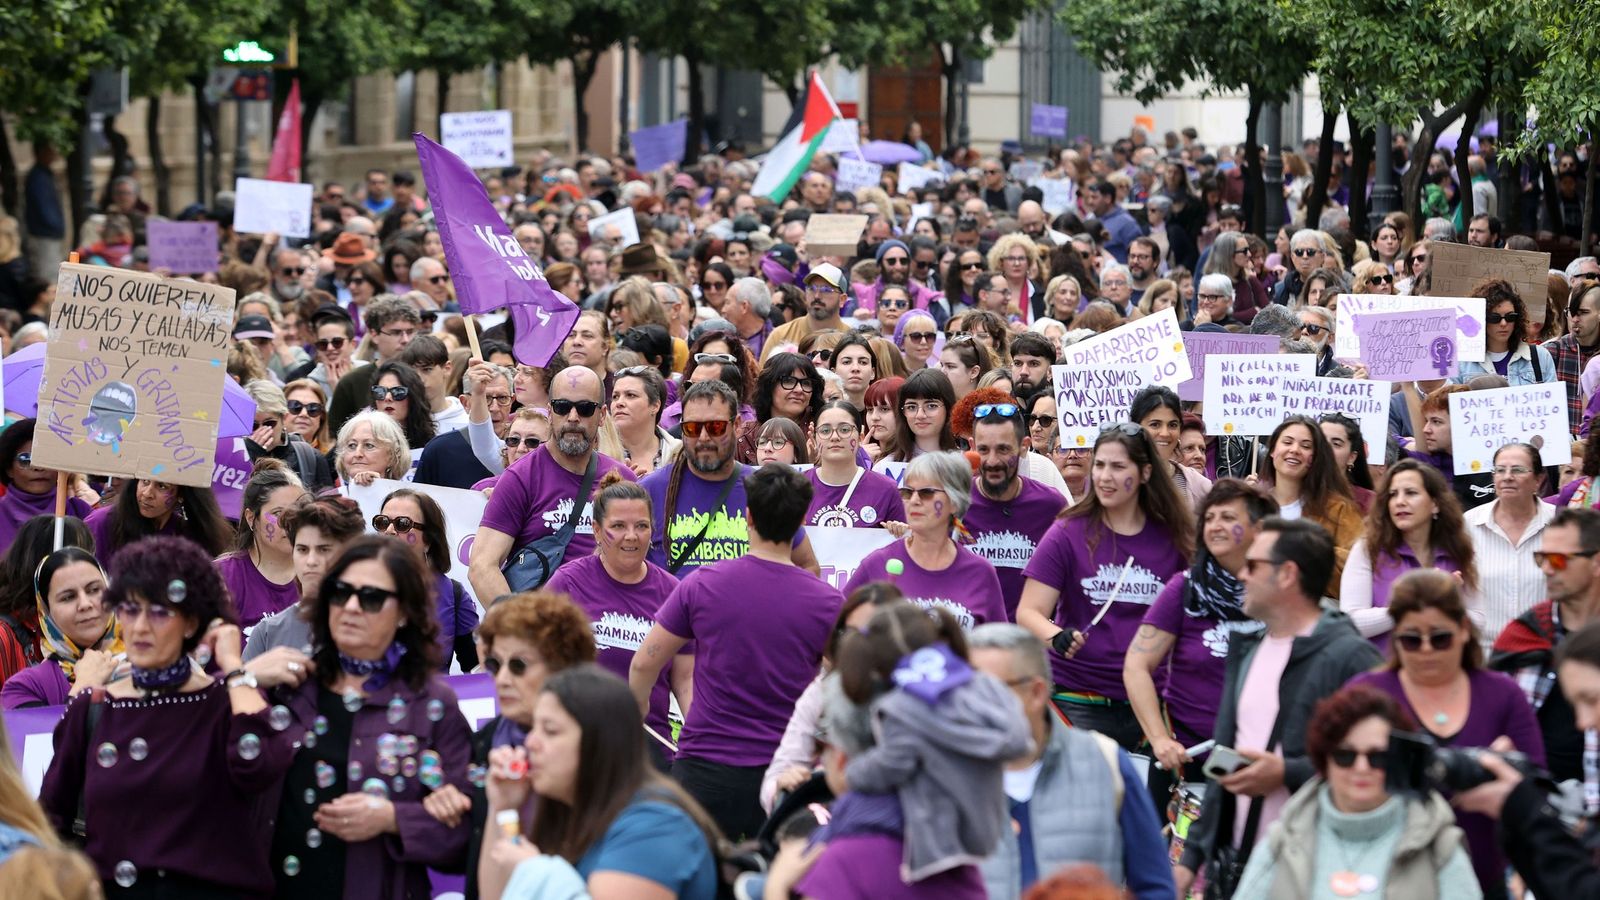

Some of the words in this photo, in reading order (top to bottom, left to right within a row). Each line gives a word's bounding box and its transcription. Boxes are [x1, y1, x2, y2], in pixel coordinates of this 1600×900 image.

[73, 275, 115, 301] NOS
[119, 279, 215, 312] QUIEREN
[55, 302, 122, 332] MUSAS
[130, 310, 143, 334] Y
[146, 314, 228, 348] CALLADAS,
[99, 336, 131, 353] NOS
[136, 339, 189, 358] TEMEN
[121, 355, 139, 379] Y
[1222, 360, 1235, 372] NI
[47, 356, 109, 446] ARTISTAS
[1282, 395, 1299, 409] TU
[1460, 397, 1495, 409] DAME
[1505, 393, 1519, 405] MI
[1523, 390, 1552, 404] SITIO
[136, 368, 206, 472] GRITANDO!
[1464, 411, 1477, 424] SI
[1490, 409, 1504, 419] TE
[1515, 406, 1560, 418] HABLO
[1470, 423, 1506, 437] ABRE
[1522, 420, 1547, 432] LOS
[552, 512, 593, 527] SABA
[811, 504, 833, 524] MAREA
[834, 504, 860, 523] VLETA
[595, 624, 646, 644] SAMBAS
